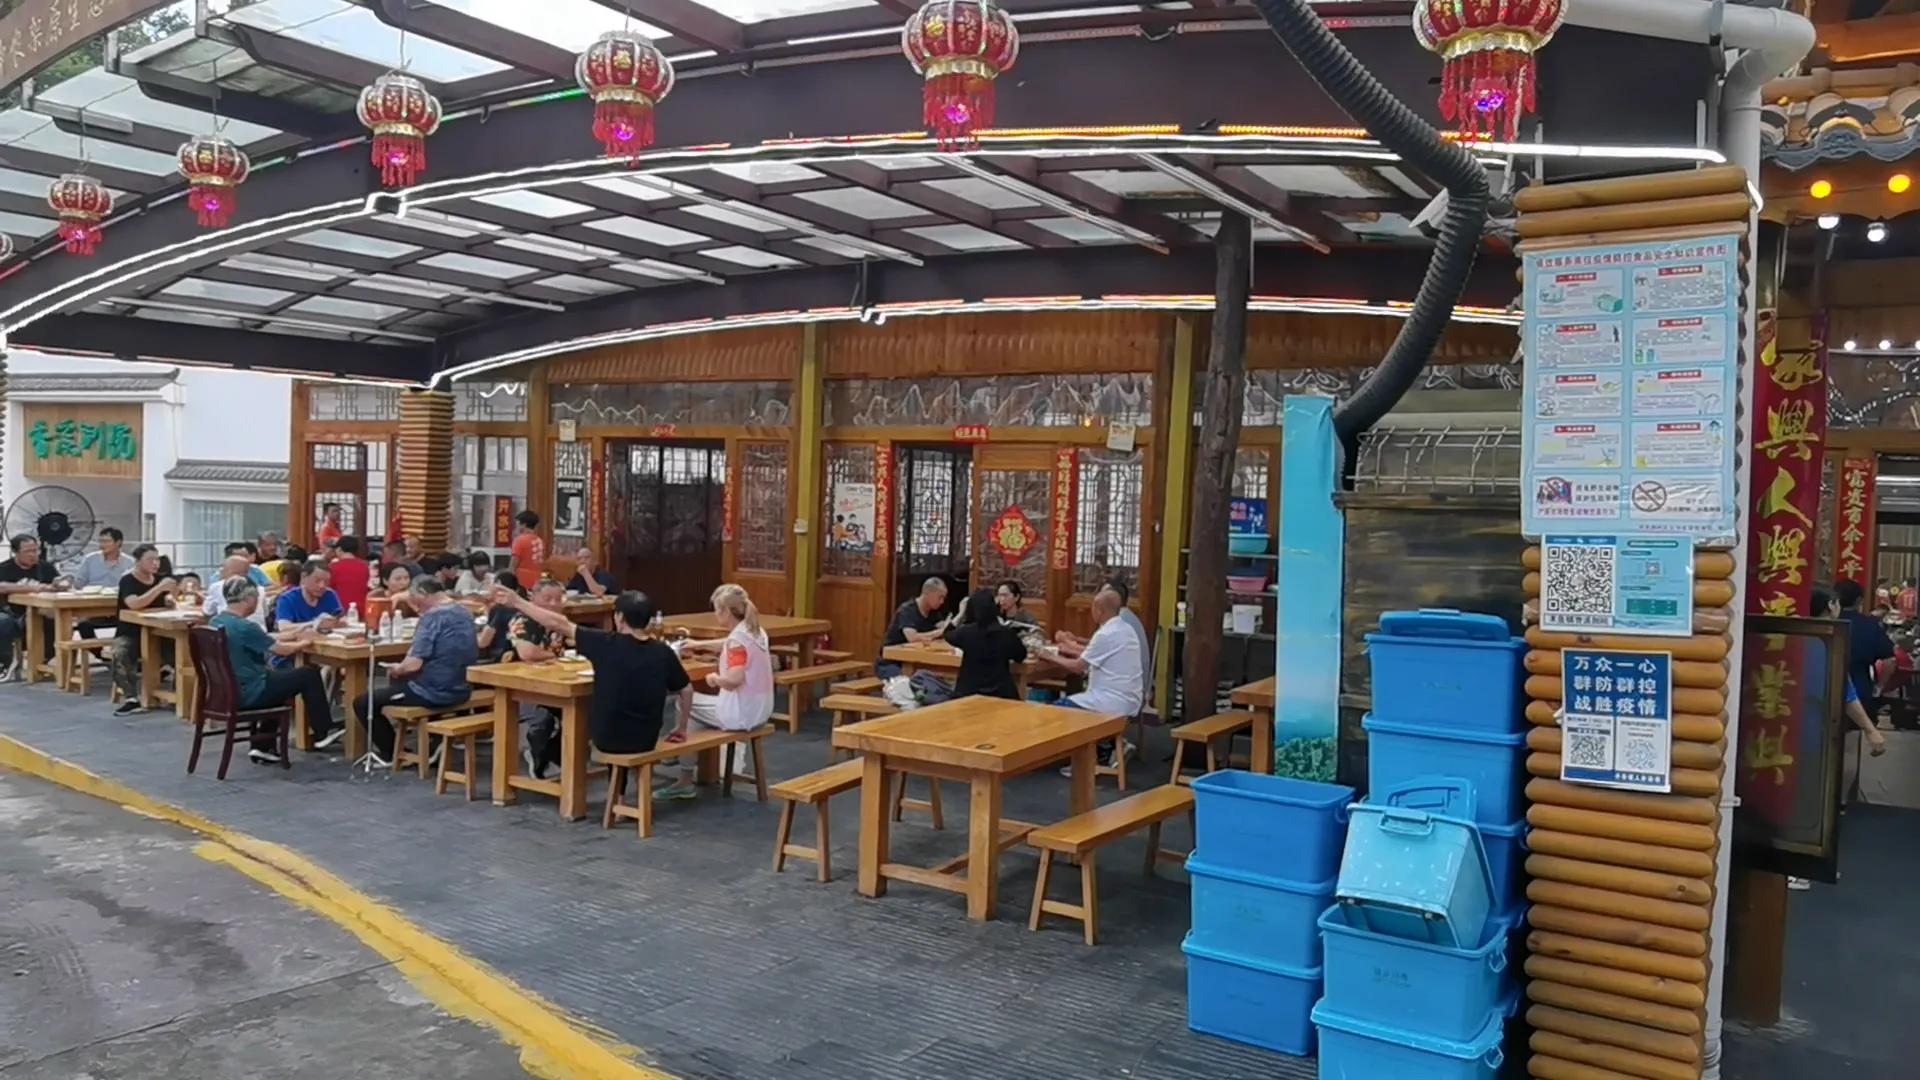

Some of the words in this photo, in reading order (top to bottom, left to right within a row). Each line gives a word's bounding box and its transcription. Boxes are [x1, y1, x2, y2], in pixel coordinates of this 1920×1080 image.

[998, 524, 1026, 549] 福
[1574, 656, 1657, 674] 万众一心
[1573, 675, 1657, 694] 群防群控
[1574, 695, 1657, 716] 战胜疫情
